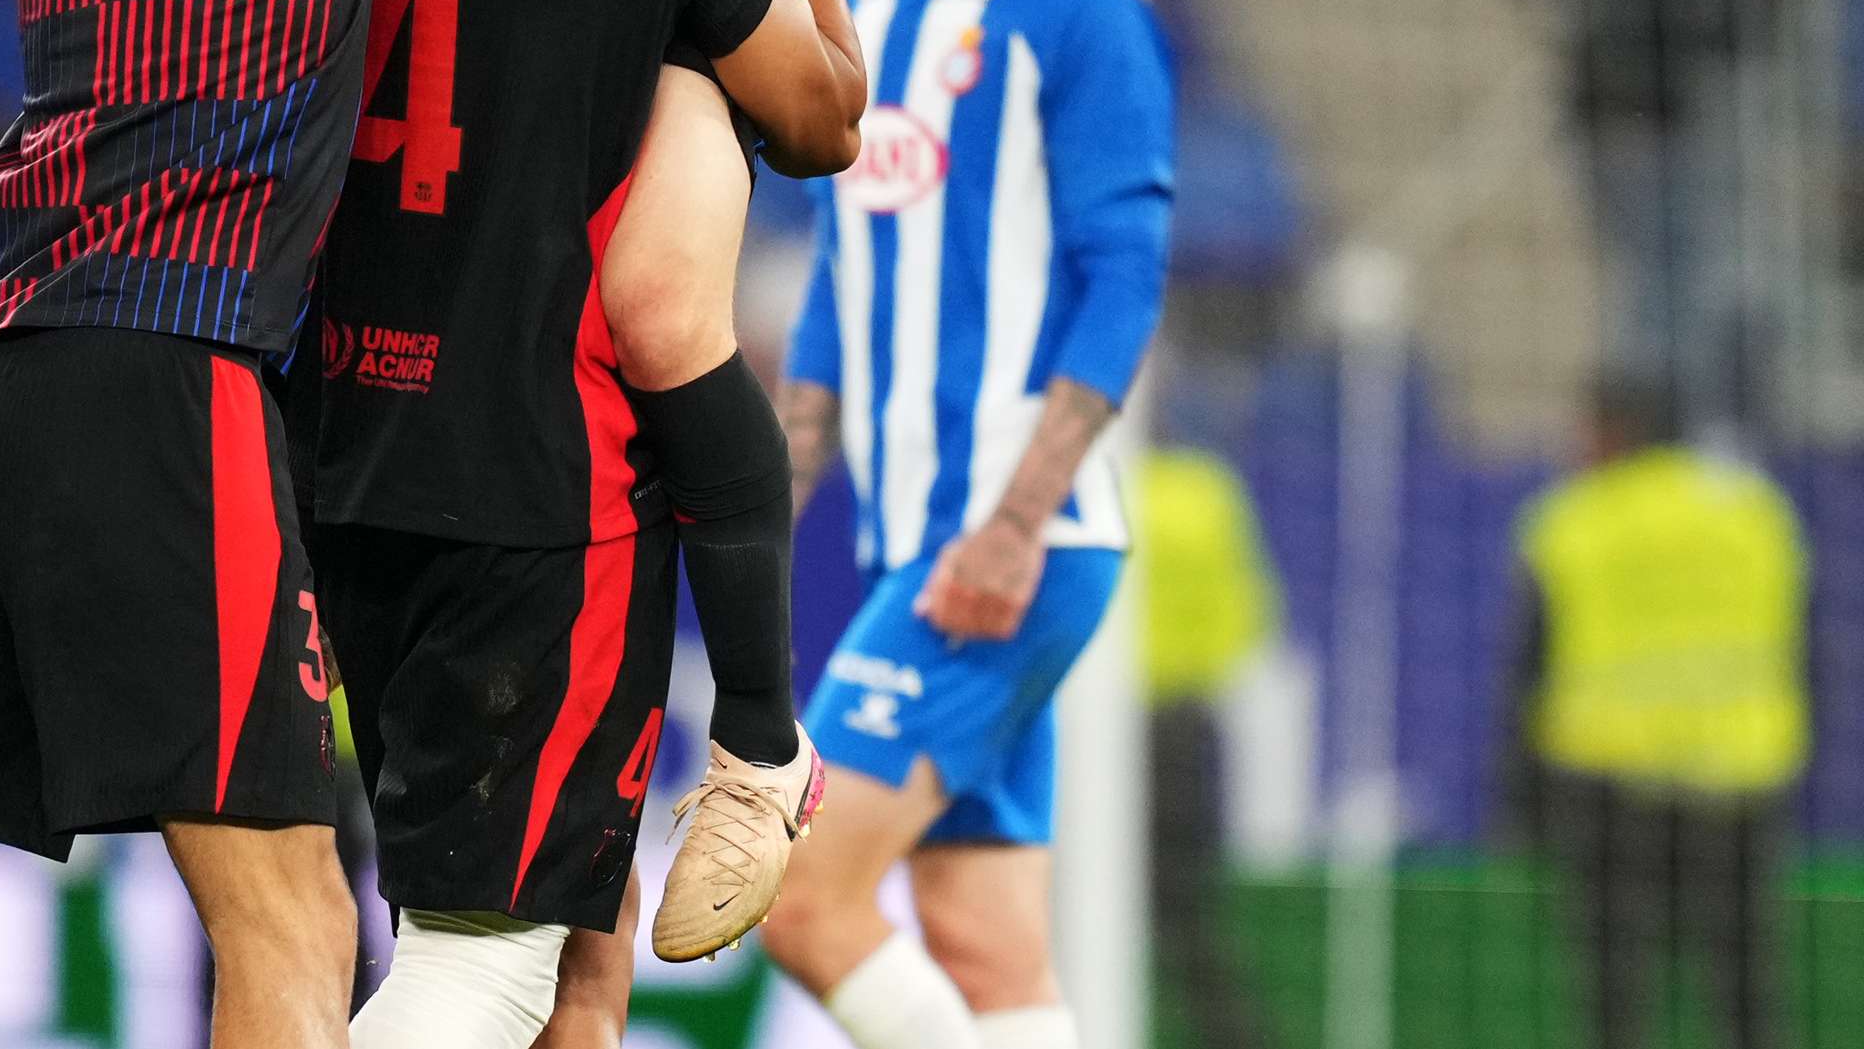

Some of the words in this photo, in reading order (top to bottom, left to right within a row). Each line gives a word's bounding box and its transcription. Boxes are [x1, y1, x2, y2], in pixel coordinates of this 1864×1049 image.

[361, 325, 440, 358] UNHCR
[356, 351, 435, 382] ACNUR
[616, 706, 665, 818] 4
